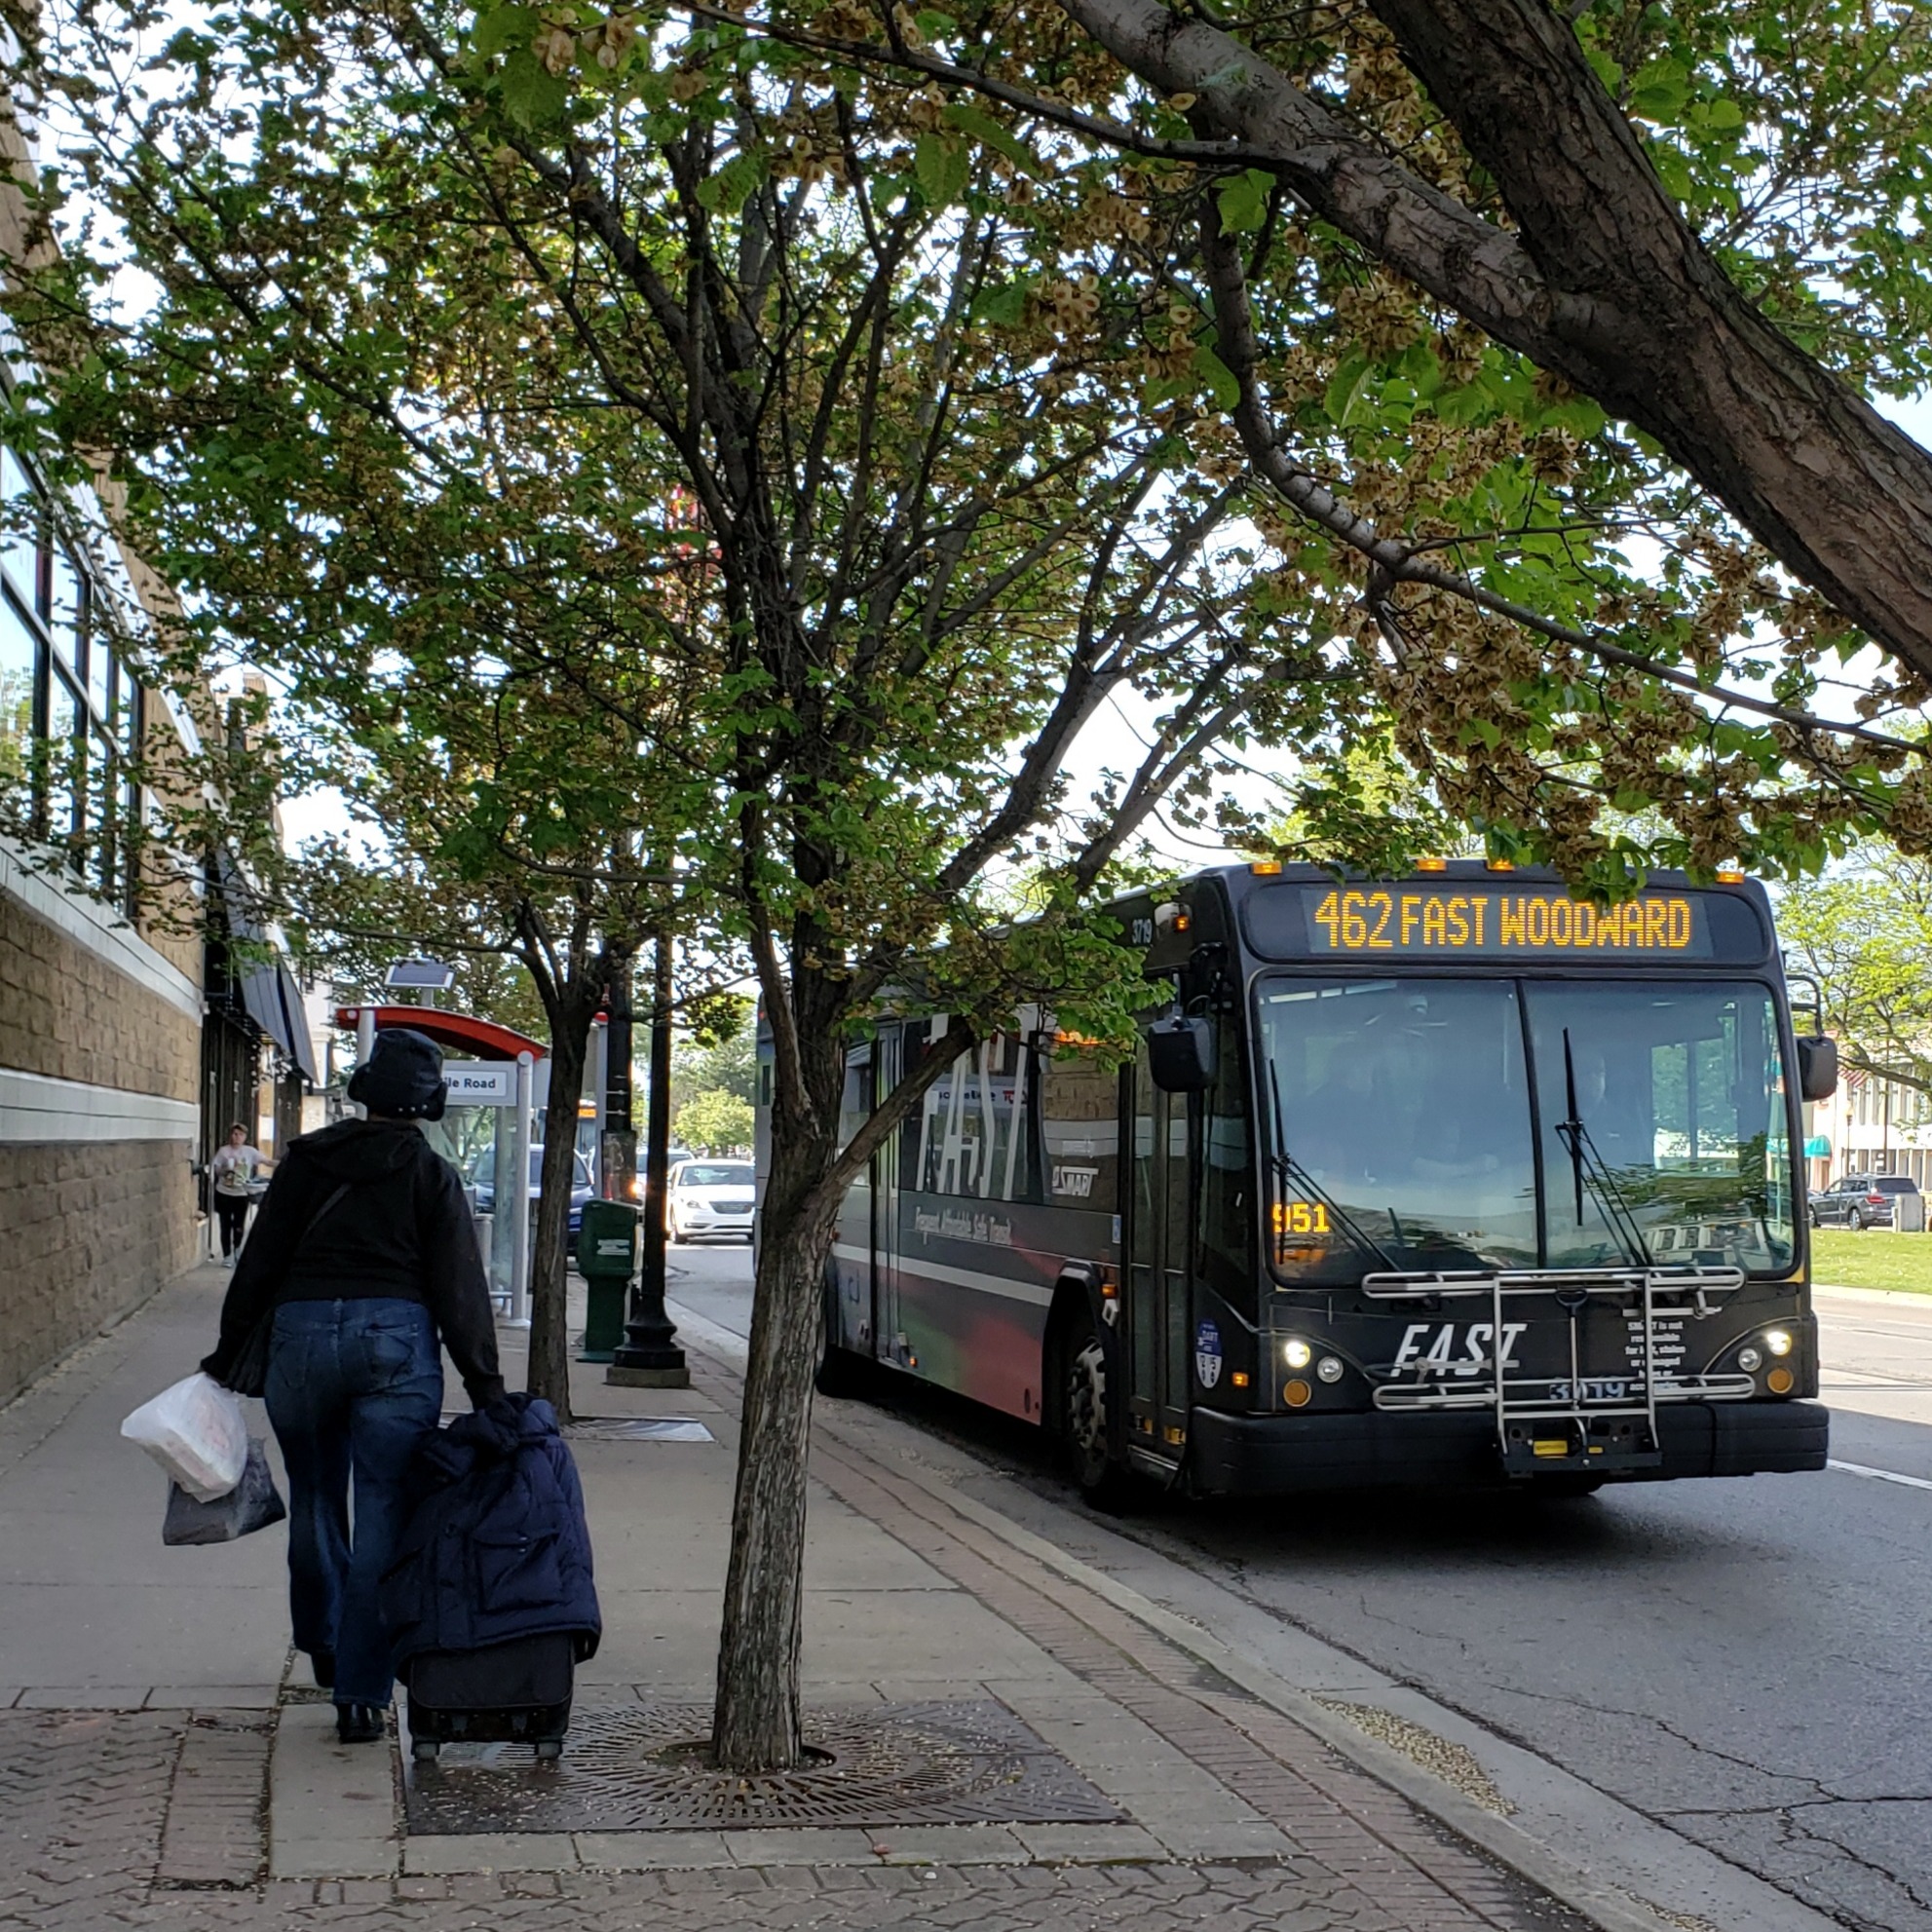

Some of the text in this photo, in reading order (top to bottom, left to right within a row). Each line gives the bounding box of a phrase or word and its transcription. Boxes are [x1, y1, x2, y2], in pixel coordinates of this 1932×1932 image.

[1314, 891, 1690, 948] 462 FAST WOODWARD
[444, 1077, 496, 1089] ile Road
[1051, 1165, 1099, 1197] SMART
[1390, 1324, 1527, 1377] FAST
[1549, 1382, 1625, 1400] 319
